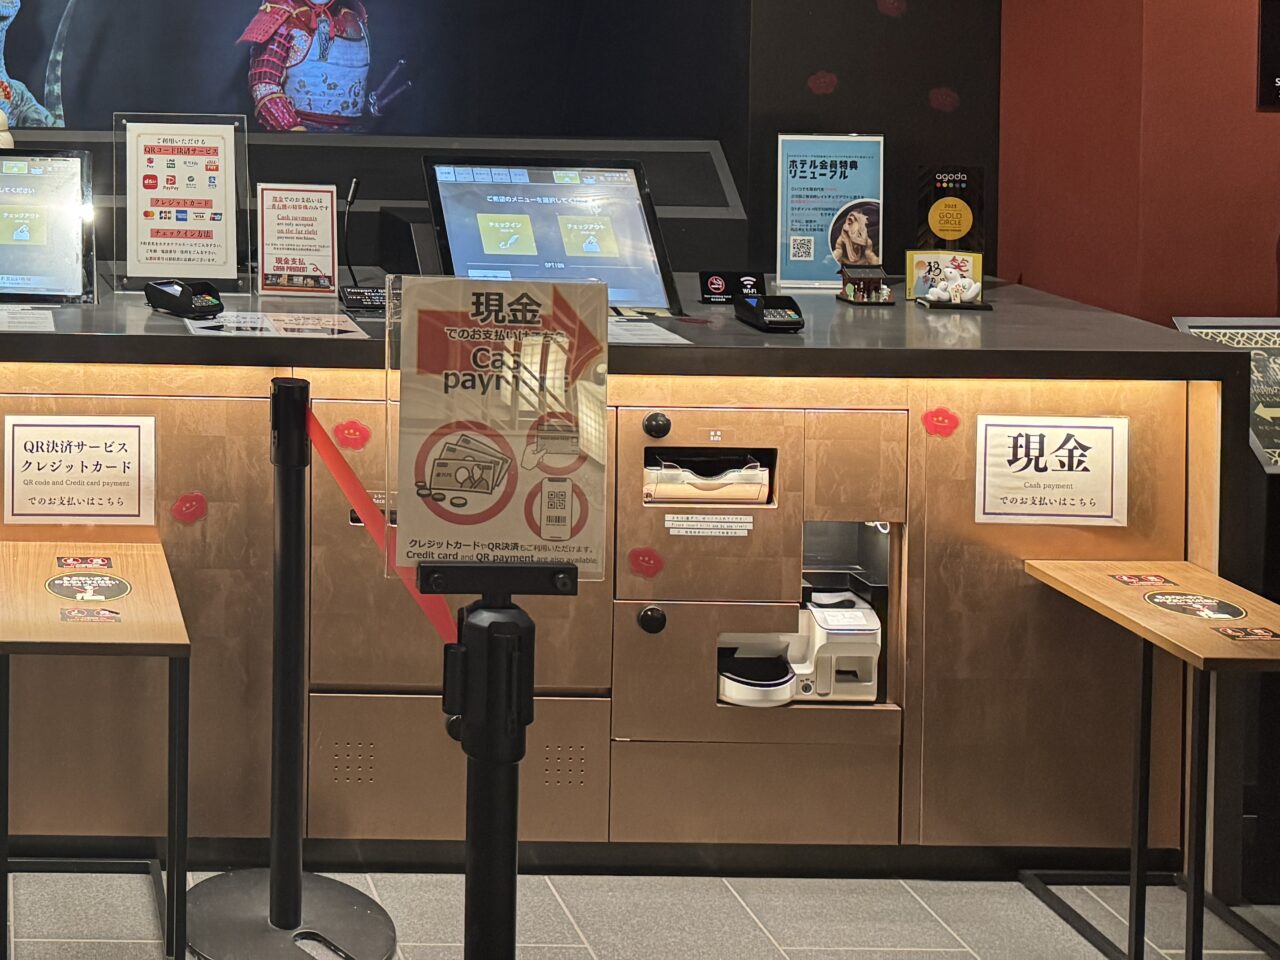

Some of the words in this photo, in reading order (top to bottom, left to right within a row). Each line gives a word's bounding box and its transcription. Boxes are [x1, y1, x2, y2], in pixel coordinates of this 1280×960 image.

[144, 146, 219, 155] QRコード決済サービス
[789, 159, 858, 170] ホテル会員特典
[789, 169, 849, 180] リニューアル
[936, 172, 967, 181] agoda
[155, 230, 211, 238] チェックイン方法
[275, 257, 306, 265] 現金支払
[470, 291, 543, 326] 現金
[23, 440, 128, 454] QR決済サービス
[1006, 432, 1093, 474] 現金
[20, 460, 132, 474] クレジットカード
[86, 479, 100, 487] card
[27, 496, 125, 507] でのお支払いはこちら
[1000, 496, 1097, 508] でのお支払いはこちら
[408, 539, 594, 554] クレジットカードやQR決済もご利用いただけます。
[406, 551, 436, 560] Credit
[437, 552, 458, 560] card
[476, 552, 490, 562] QR
[492, 553, 534, 563] payment
